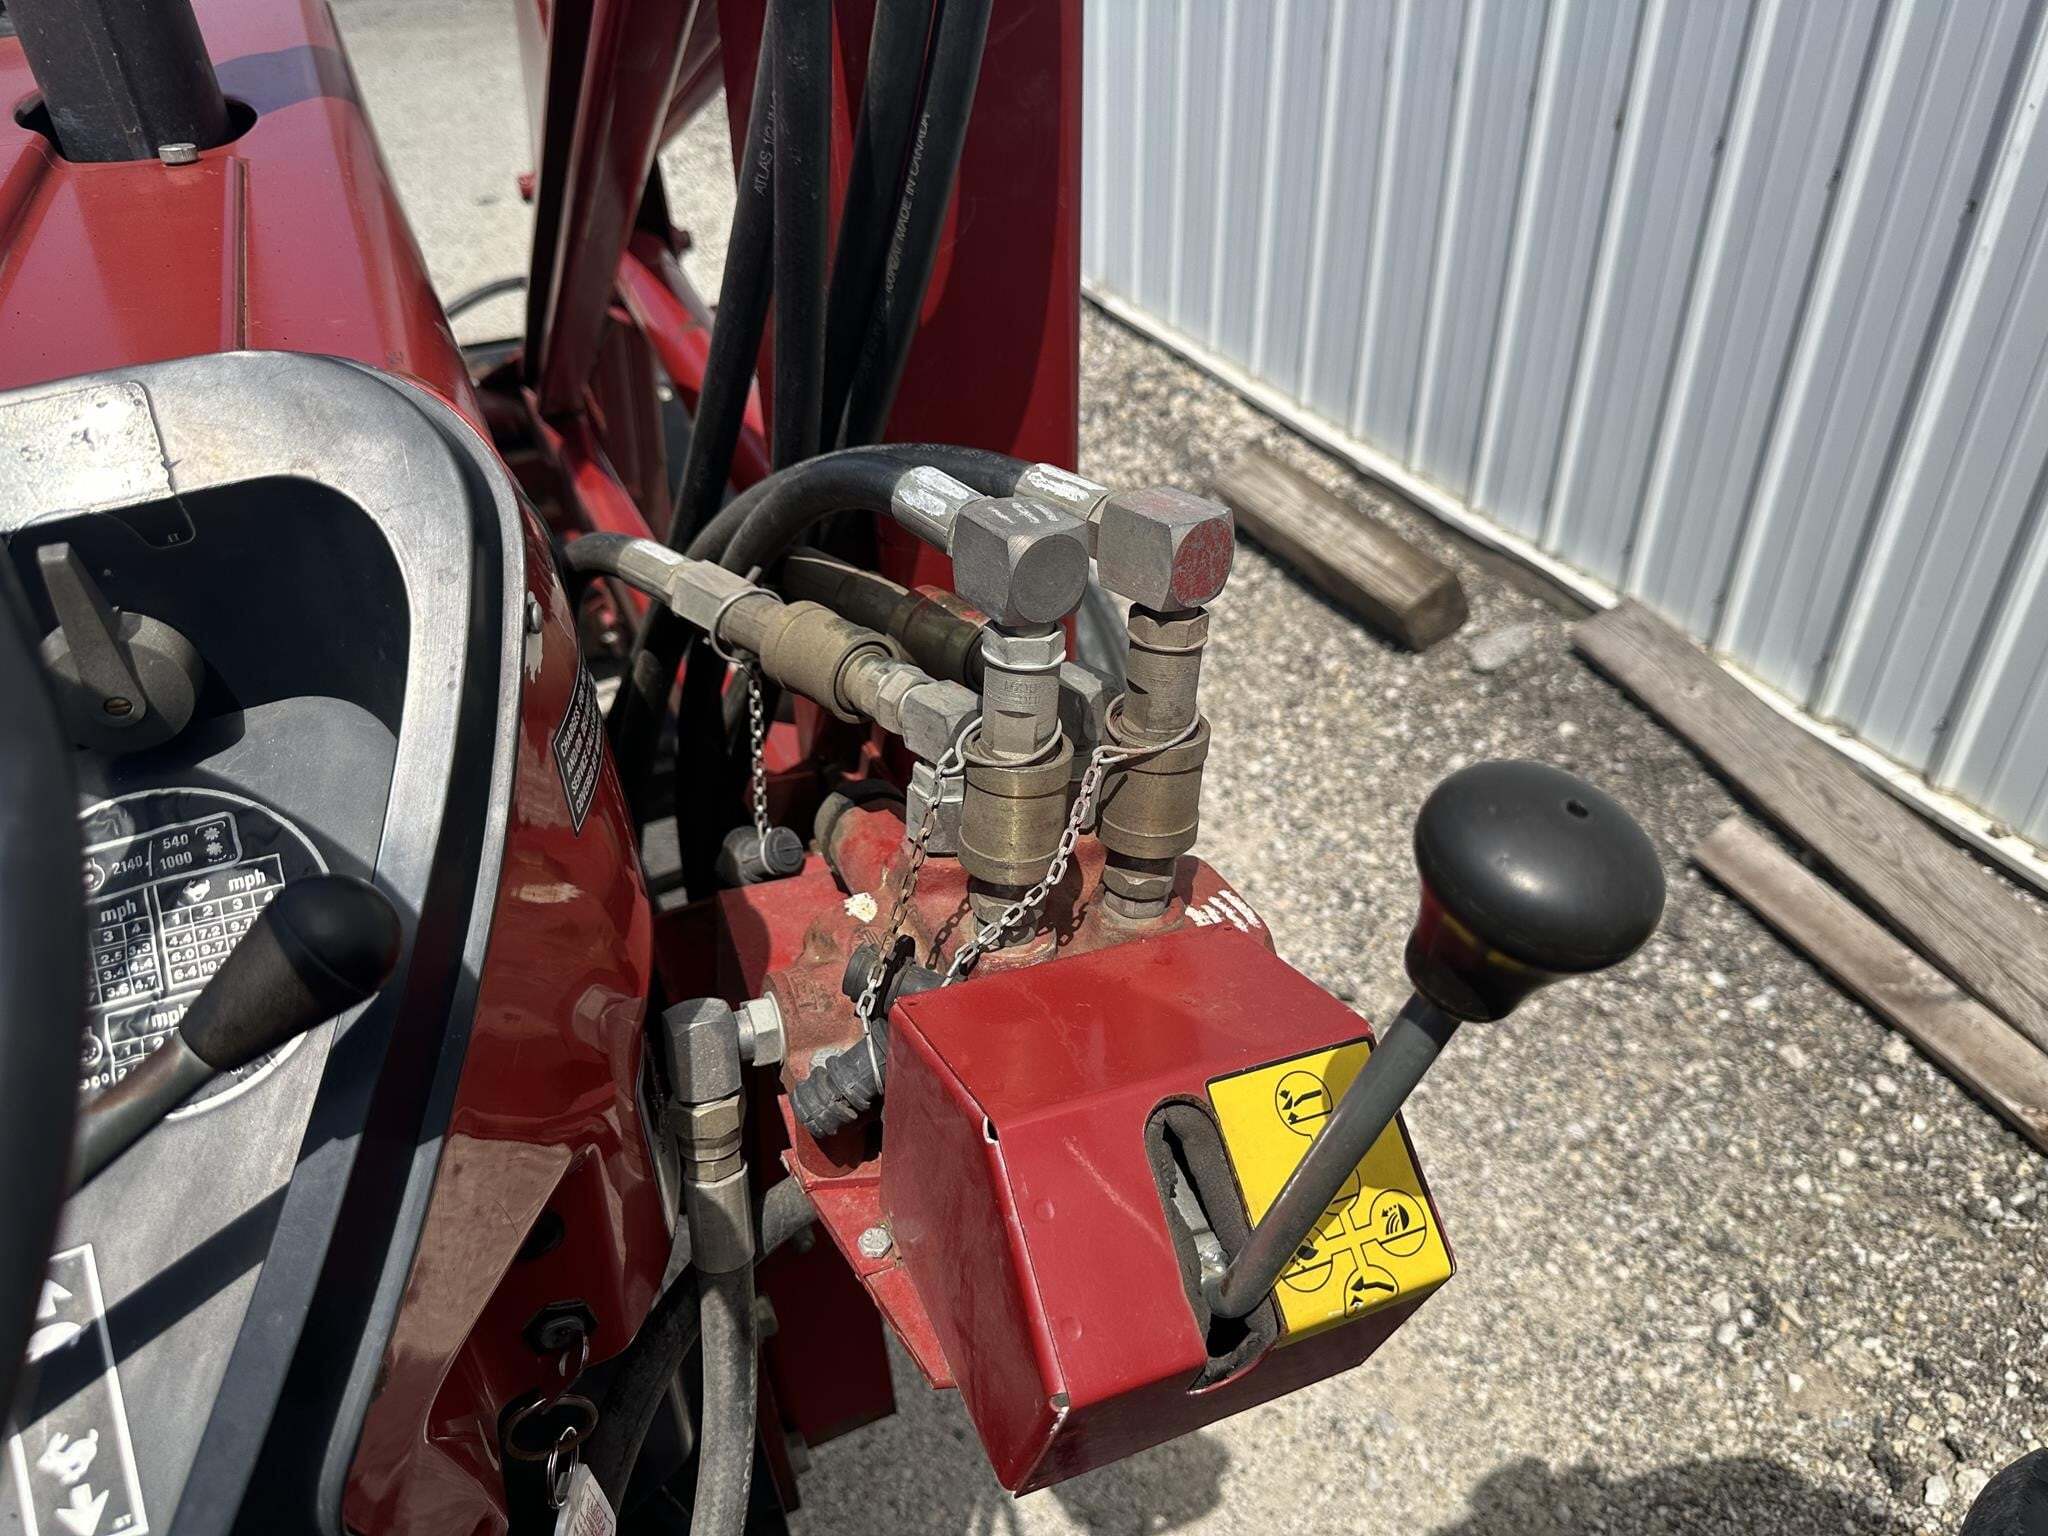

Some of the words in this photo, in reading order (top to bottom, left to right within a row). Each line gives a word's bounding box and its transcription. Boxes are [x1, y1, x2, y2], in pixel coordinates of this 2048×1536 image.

[895, 196, 912, 240] MADE
[905, 178, 916, 196] IN
[162, 834, 189, 849] 540
[112, 856, 143, 875] 2140
[160, 851, 193, 870] 1000
[228, 869, 266, 891] mph
[101, 900, 137, 922] mph
[172, 913, 180, 925] 1
[203, 905, 214, 917] 2
[232, 897, 243, 911] 3
[103, 930, 114, 942] 3
[132, 923, 141, 933] 4
[169, 933, 193, 946] 4.4
[199, 926, 220, 939] 7.2
[101, 951, 123, 964] 2.5
[128, 942, 151, 955] 3.3
[171, 948, 195, 962] 6.0
[201, 941, 224, 955] 9.7
[103, 966, 124, 980] 3.4
[130, 958, 153, 973] 4.4
[173, 965, 197, 980] 6.4
[107, 983, 130, 998] 3.6
[135, 975, 156, 990] 4.7
[124, 1044, 131, 1055] 1
